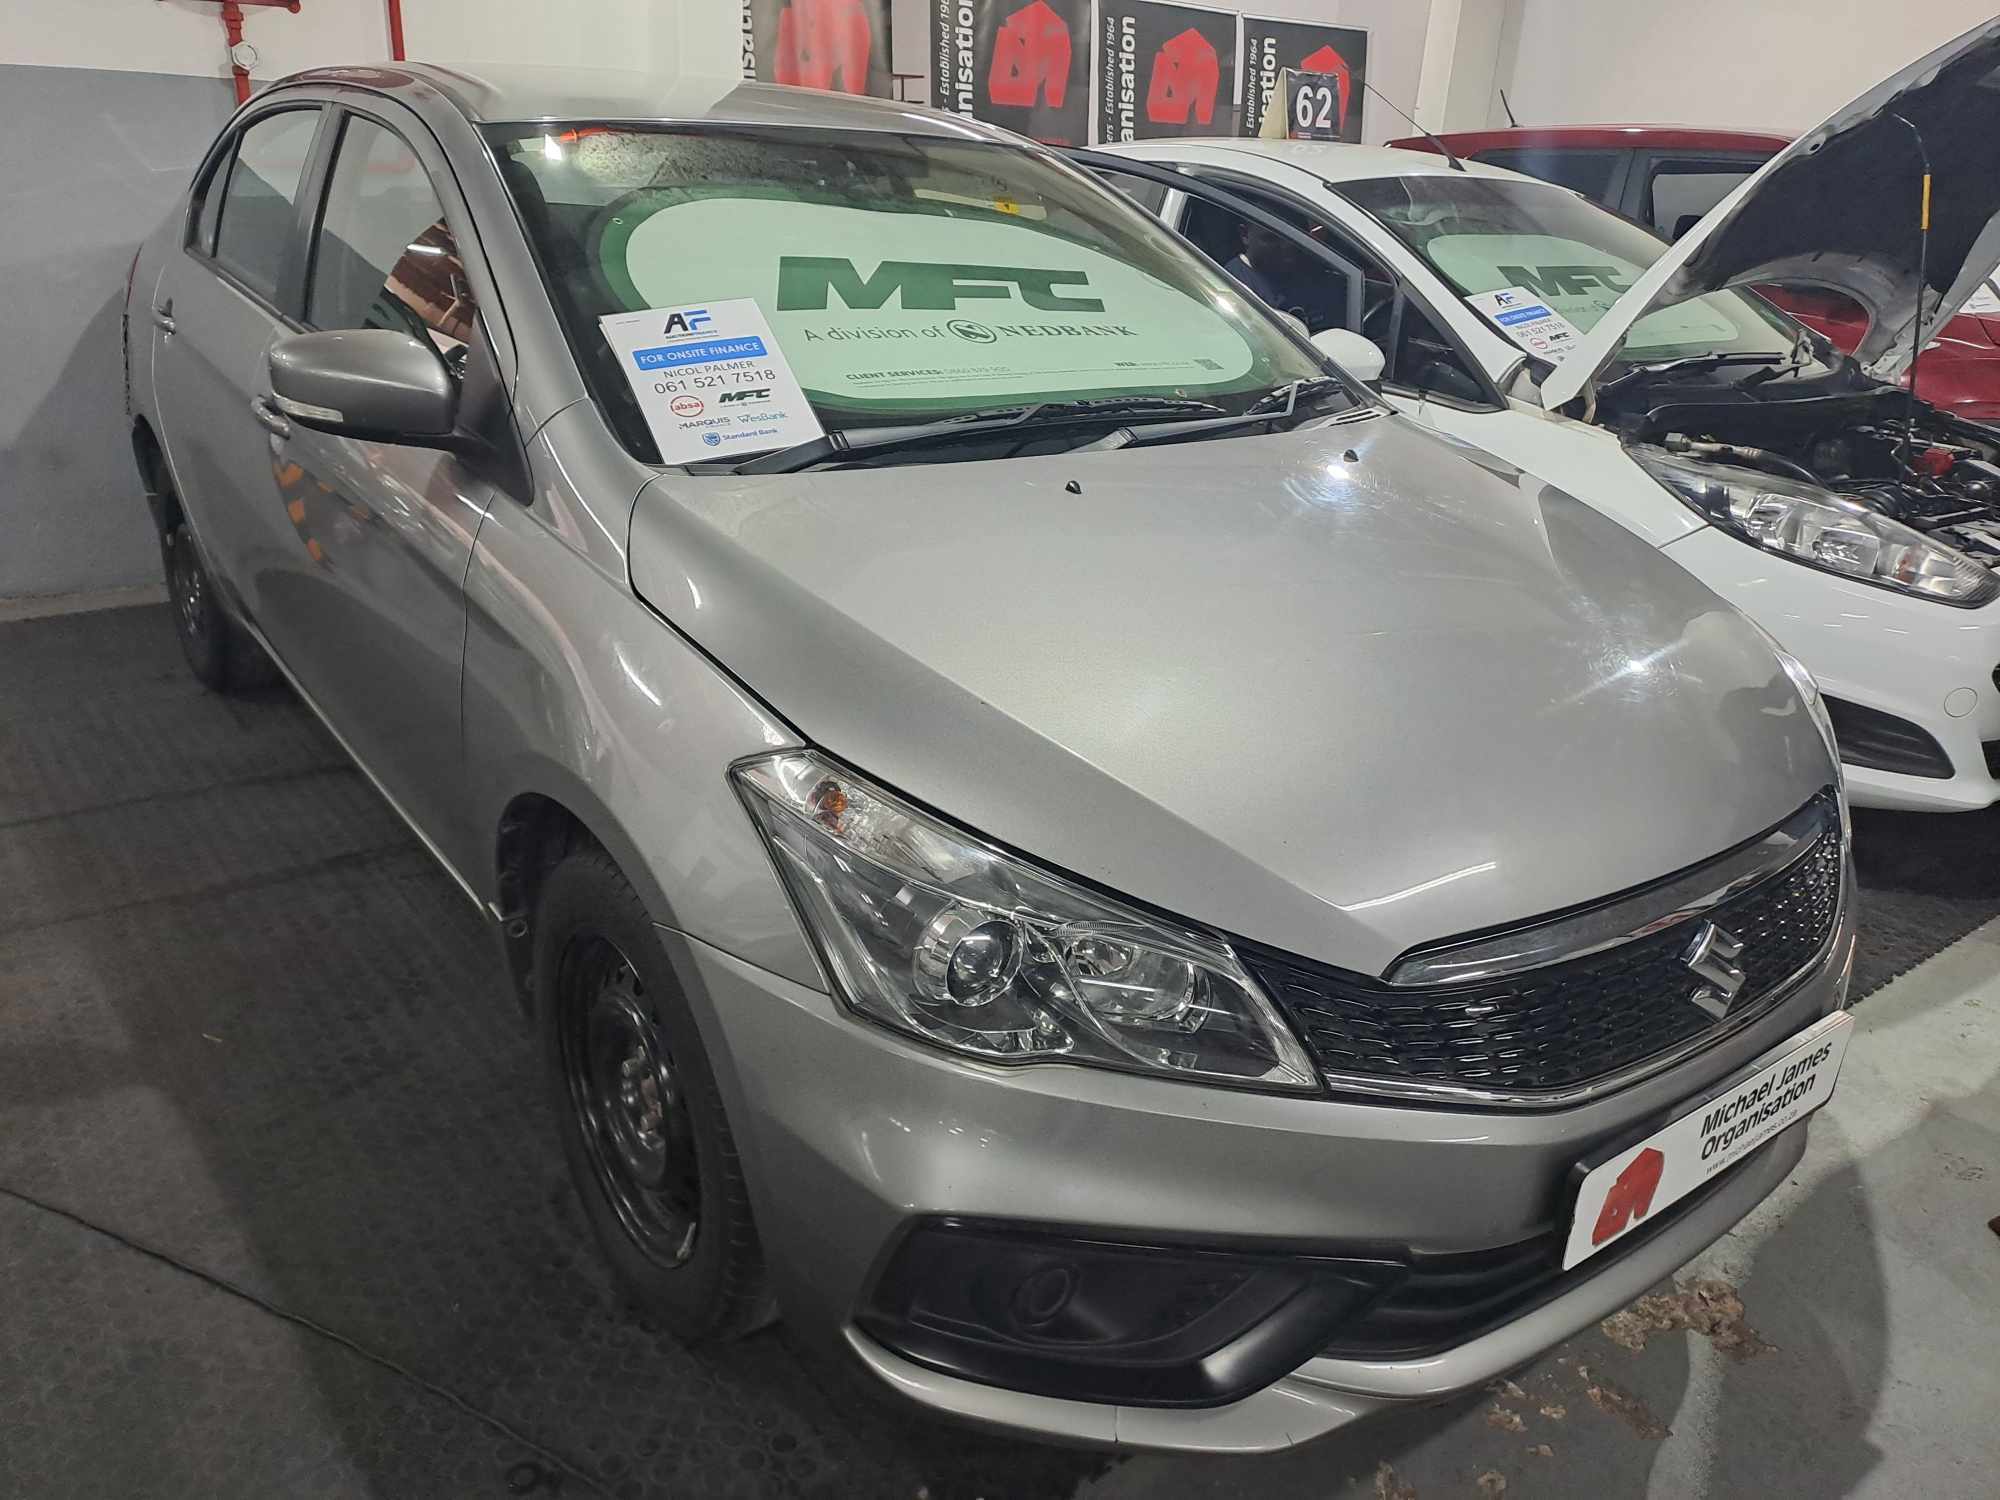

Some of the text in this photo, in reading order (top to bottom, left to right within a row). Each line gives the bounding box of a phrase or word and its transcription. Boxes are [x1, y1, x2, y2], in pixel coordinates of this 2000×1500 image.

[1106, 16, 1117, 46] 1964
[939, 22, 950, 96] Established
[1249, 38, 1258, 65] 1964
[1104, 48, 1115, 114] Established
[1246, 68, 1257, 129] Established
[1296, 85, 1332, 128] 62
[777, 255, 1106, 313] MFC
[1496, 265, 1633, 297] MFC
[664, 309, 712, 334] AF
[804, 325, 1137, 342] A division of NEDBANK
[640, 342, 760, 364] FOR ONSITE FINANCE
[654, 369, 776, 394] 061 521 7518
[663, 360, 754, 378] NICOL PALMER
[673, 398, 701, 411] absa
[719, 388, 771, 404] MFC
[679, 416, 731, 430] MARQUIS
[1700, 1042, 1833, 1138] Michael James
[1701, 1074, 1816, 1161] Organisation
